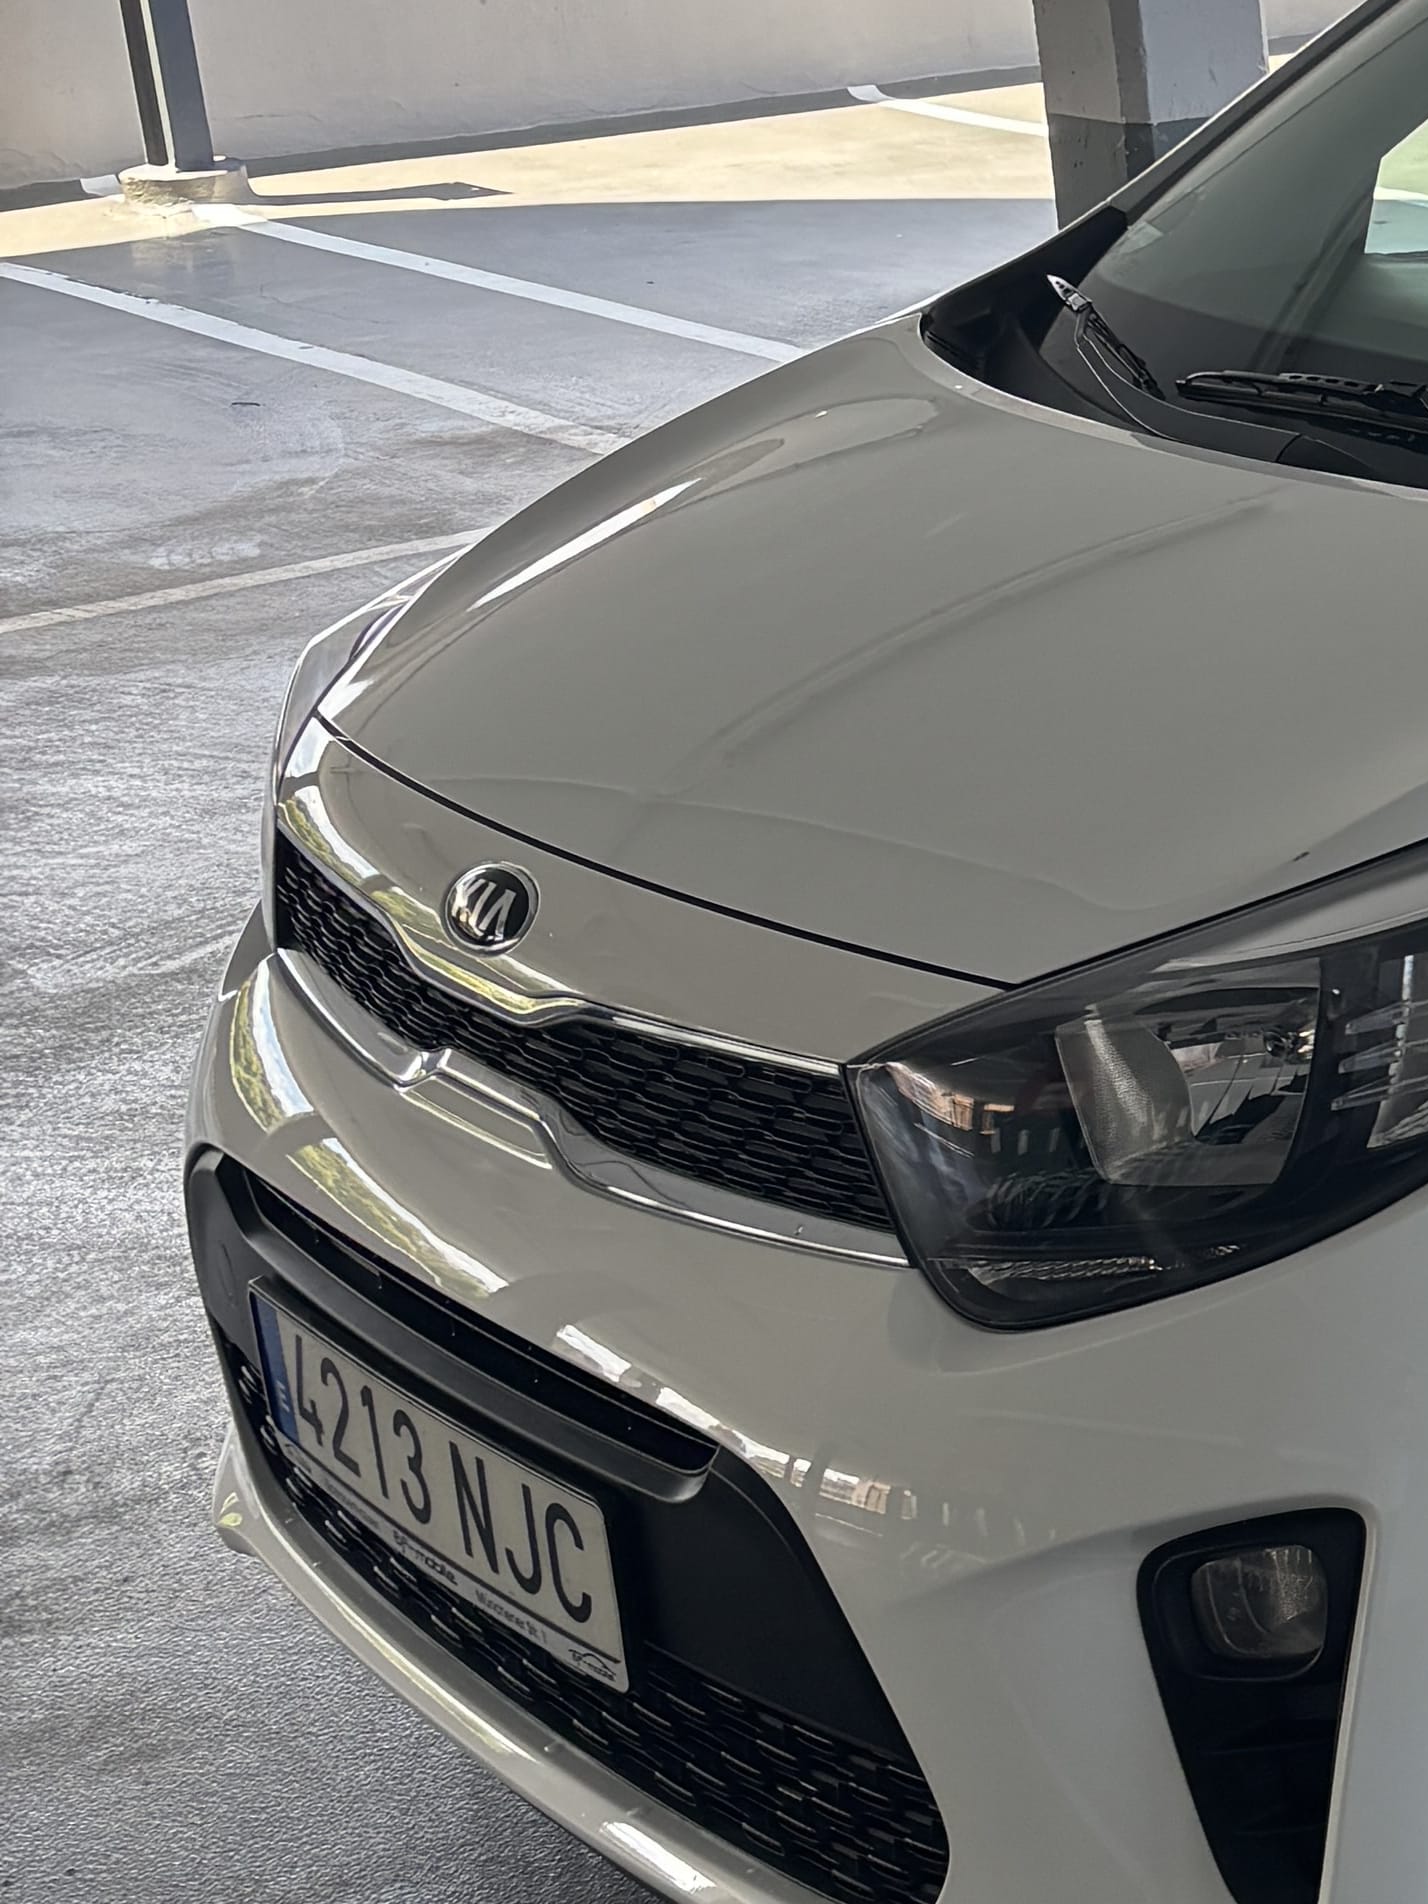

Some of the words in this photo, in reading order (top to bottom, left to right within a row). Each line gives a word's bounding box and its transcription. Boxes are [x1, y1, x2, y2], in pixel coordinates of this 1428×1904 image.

[451, 875, 517, 939] KIA
[295, 1333, 432, 1526] 4213
[449, 1440, 593, 1624] NJC
